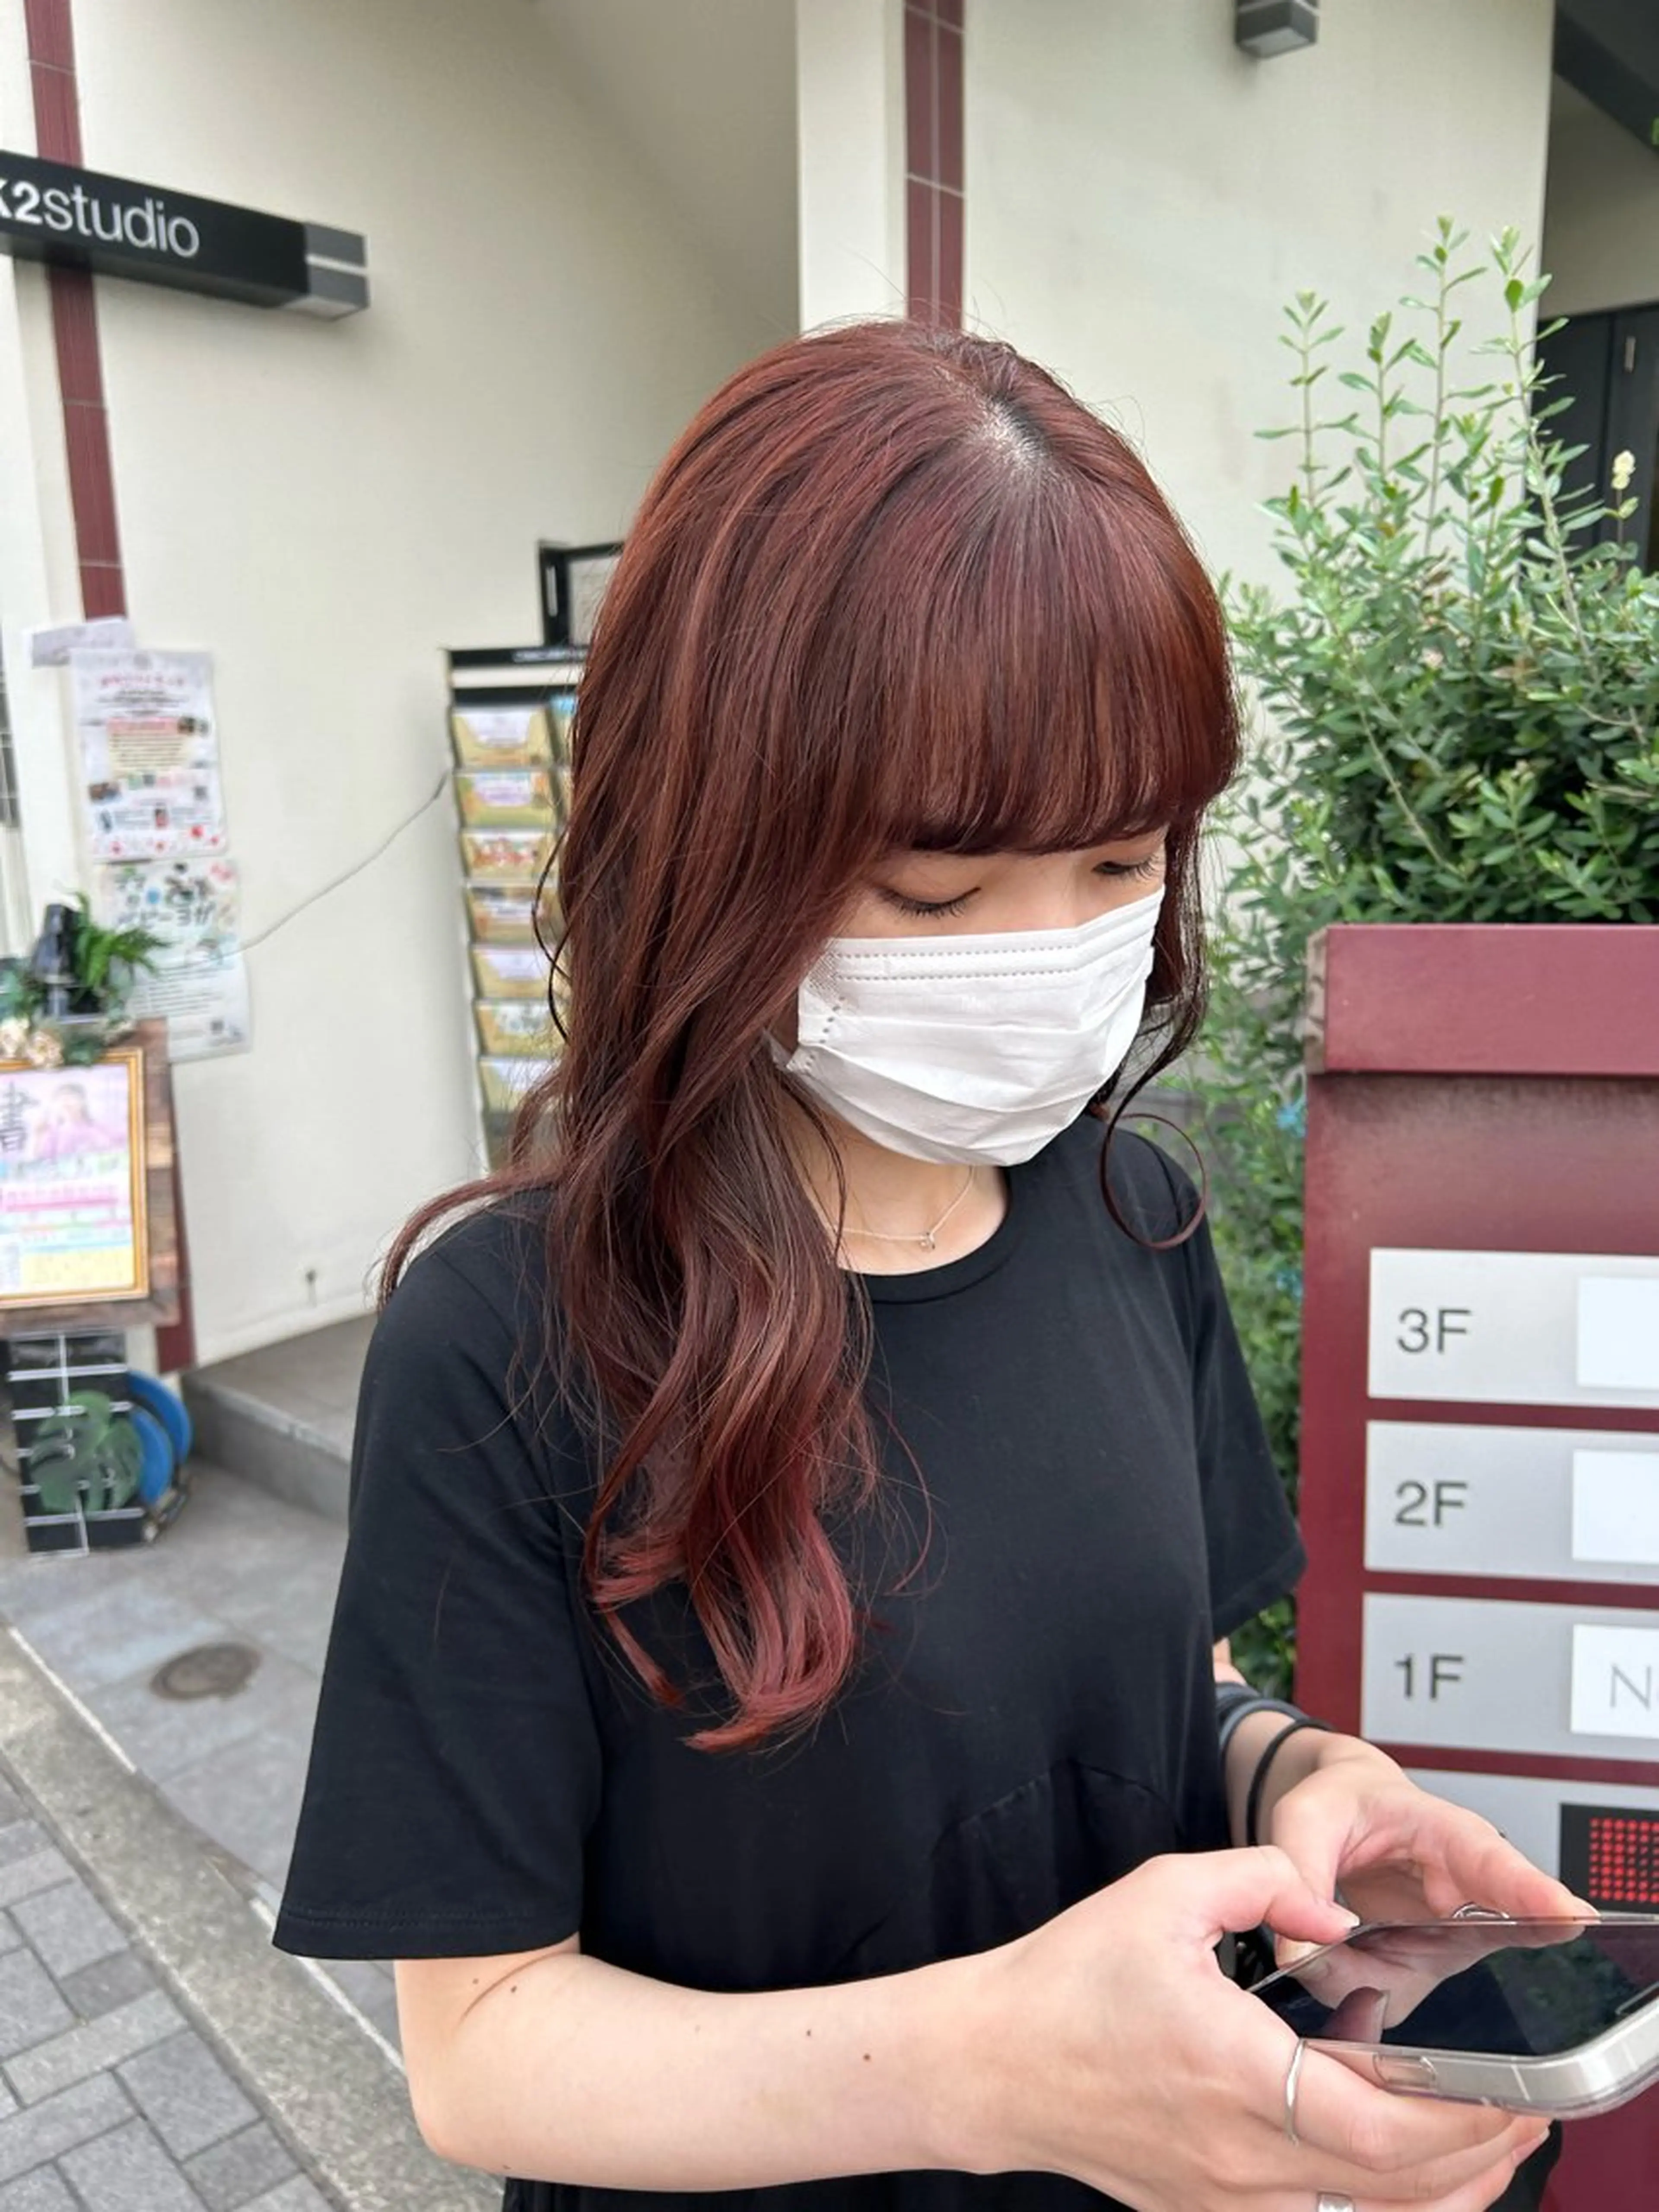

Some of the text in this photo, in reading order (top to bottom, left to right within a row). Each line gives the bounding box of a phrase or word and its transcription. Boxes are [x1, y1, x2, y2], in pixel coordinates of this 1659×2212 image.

[1397, 1307, 1472, 1354] 3F
[1394, 1480, 1468, 1527] 2F
[1395, 1654, 1464, 1700] 1F
[1609, 1664, 1659, 1710] N
